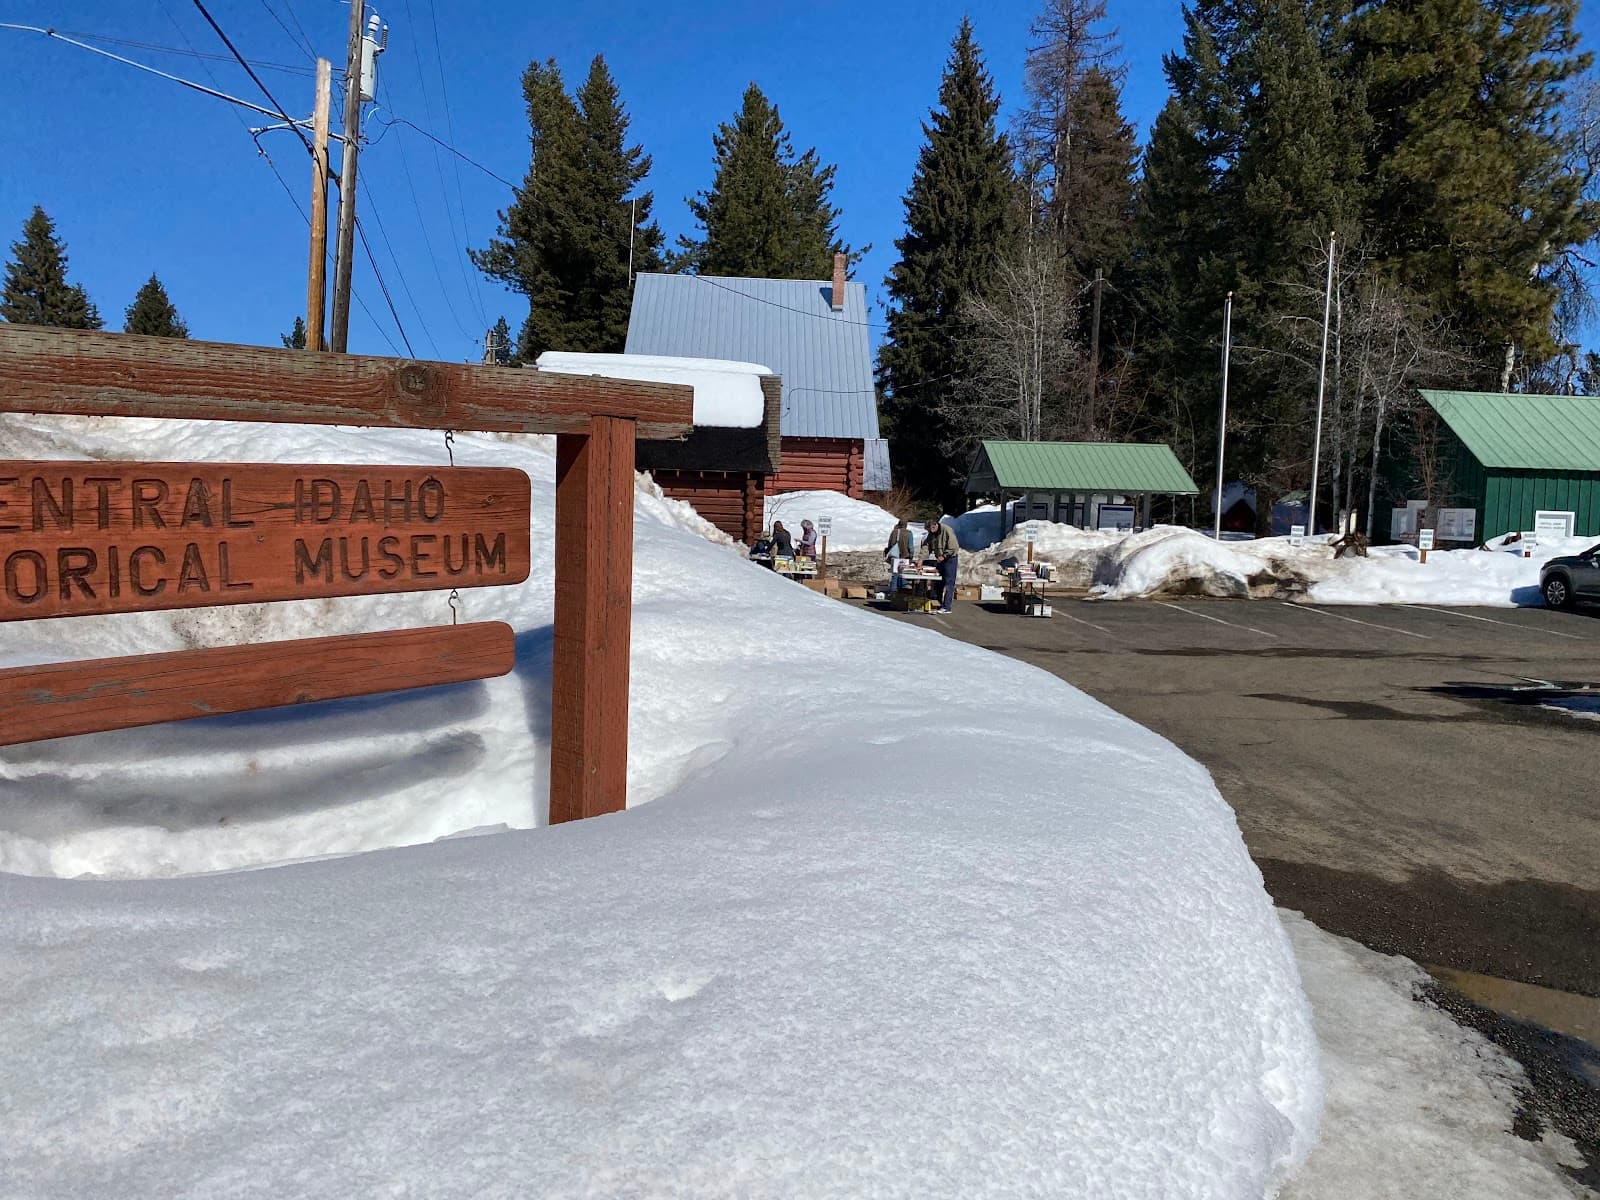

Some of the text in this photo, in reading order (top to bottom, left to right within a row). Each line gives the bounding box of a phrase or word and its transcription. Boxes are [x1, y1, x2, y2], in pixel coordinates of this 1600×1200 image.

[295, 478, 445, 525] IDAHO
[4, 532, 506, 604] ORICAL MUSEUM
